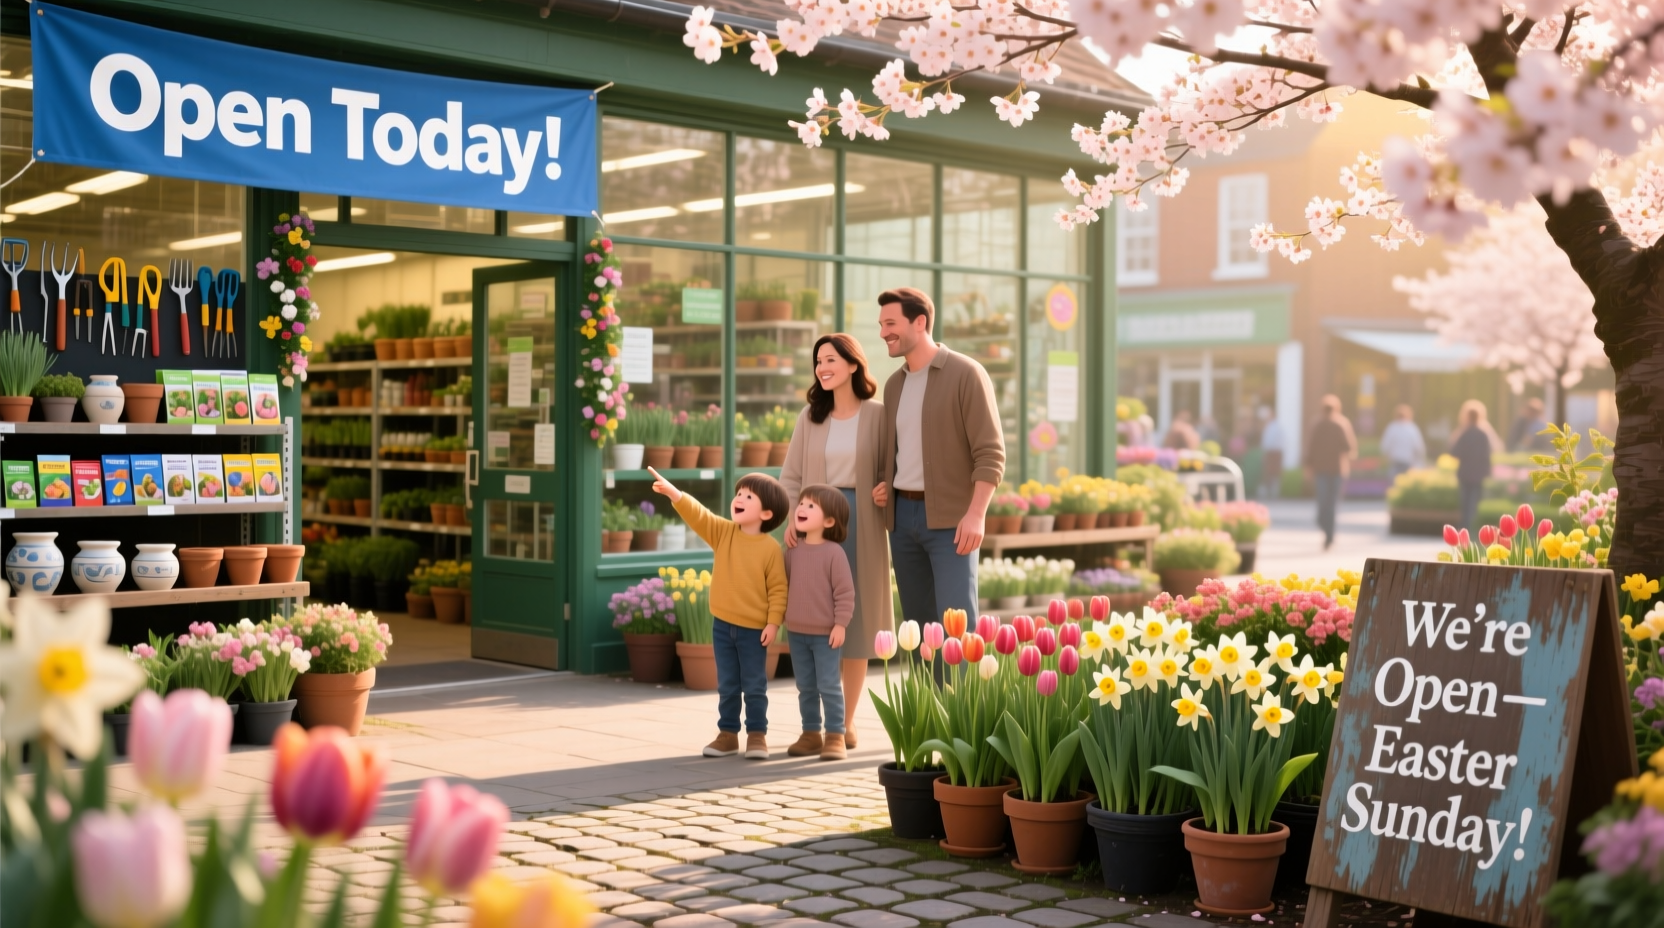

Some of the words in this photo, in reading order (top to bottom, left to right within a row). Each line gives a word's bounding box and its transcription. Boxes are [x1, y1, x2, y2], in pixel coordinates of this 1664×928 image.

[90, 52, 312, 158] Open
[331, 87, 562, 196] Today!
[1402, 599, 1531, 656] We’re
[1365, 724, 1518, 790] Easter
[1340, 782, 1533, 870] Sunday!
